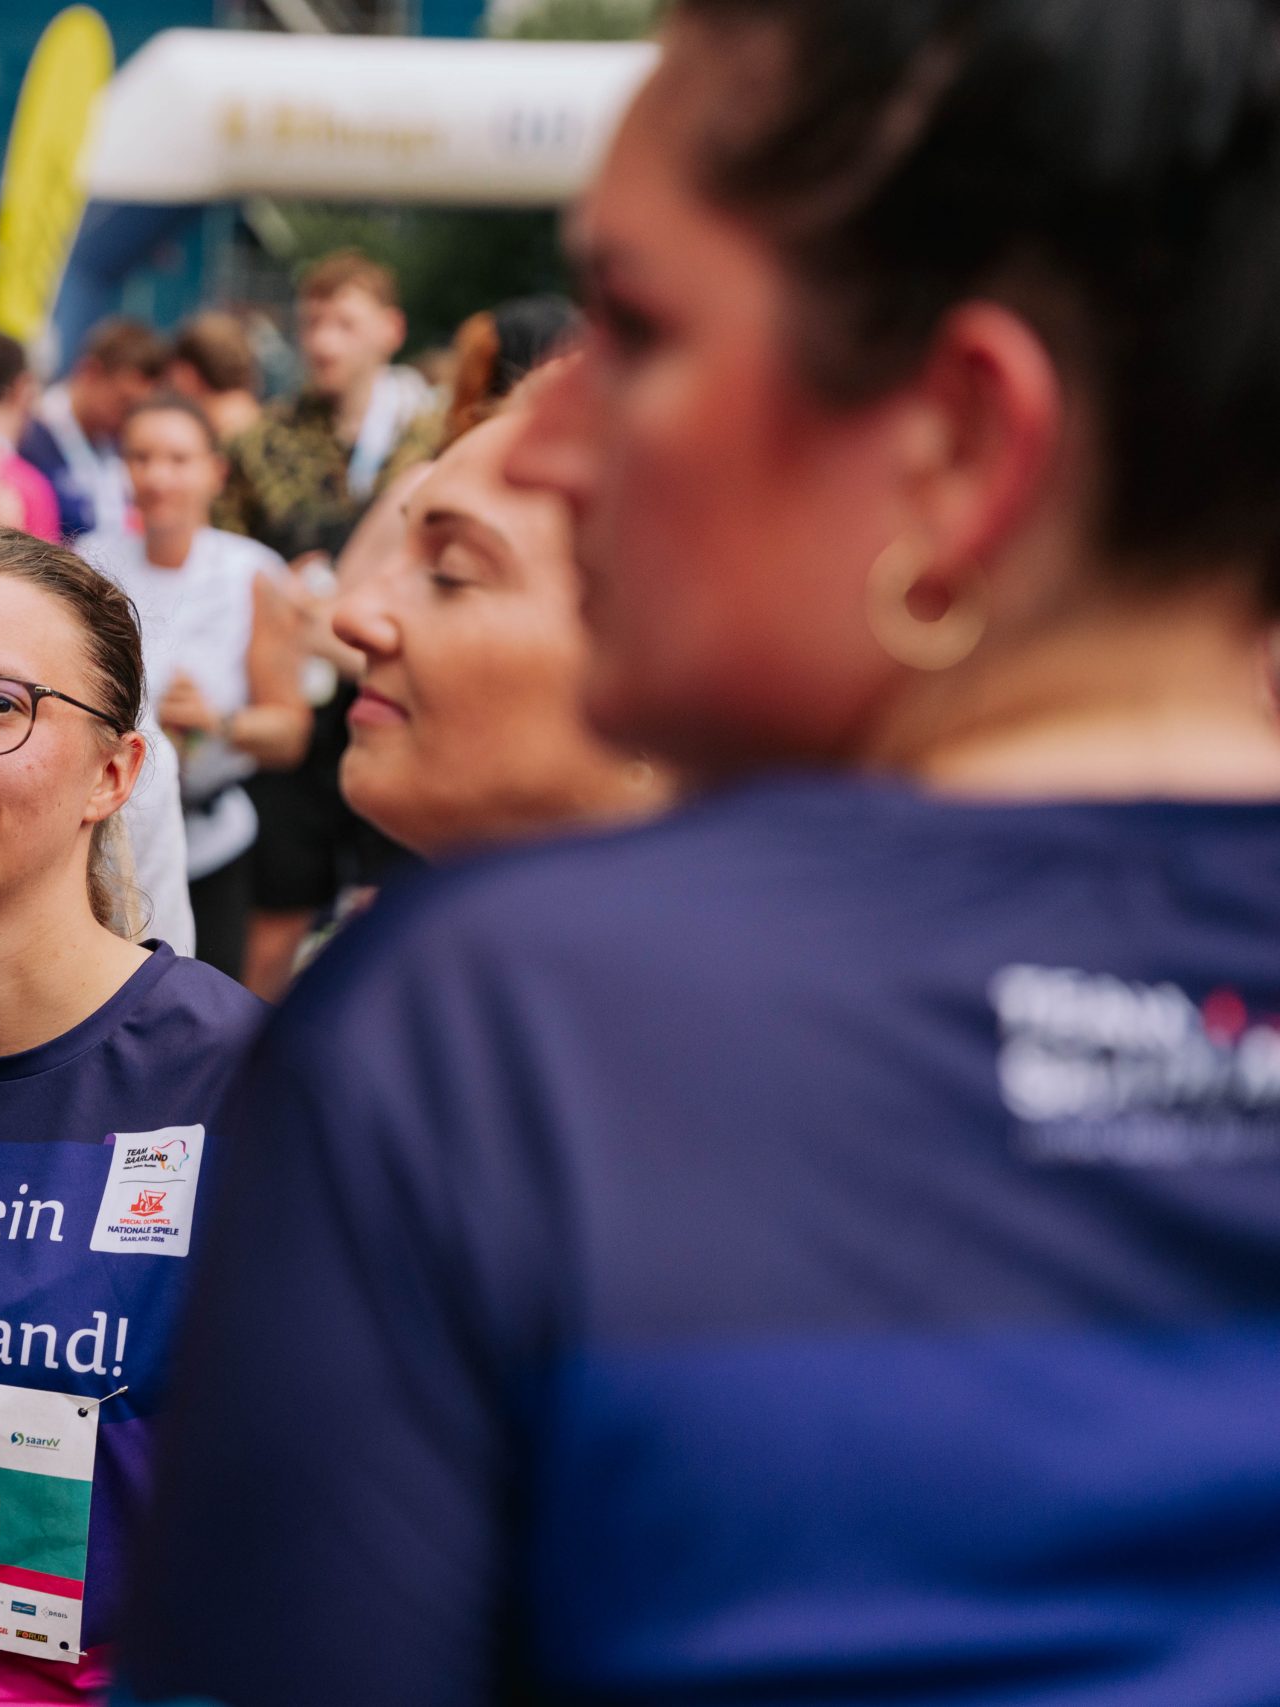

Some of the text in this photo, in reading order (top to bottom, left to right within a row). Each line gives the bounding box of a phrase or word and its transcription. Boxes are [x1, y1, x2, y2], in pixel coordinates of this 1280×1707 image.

[127, 1147, 148, 1156] TEAM
[125, 1153, 168, 1164] SAARLAND
[107, 1226, 179, 1236] NATIONALE SPIELE
